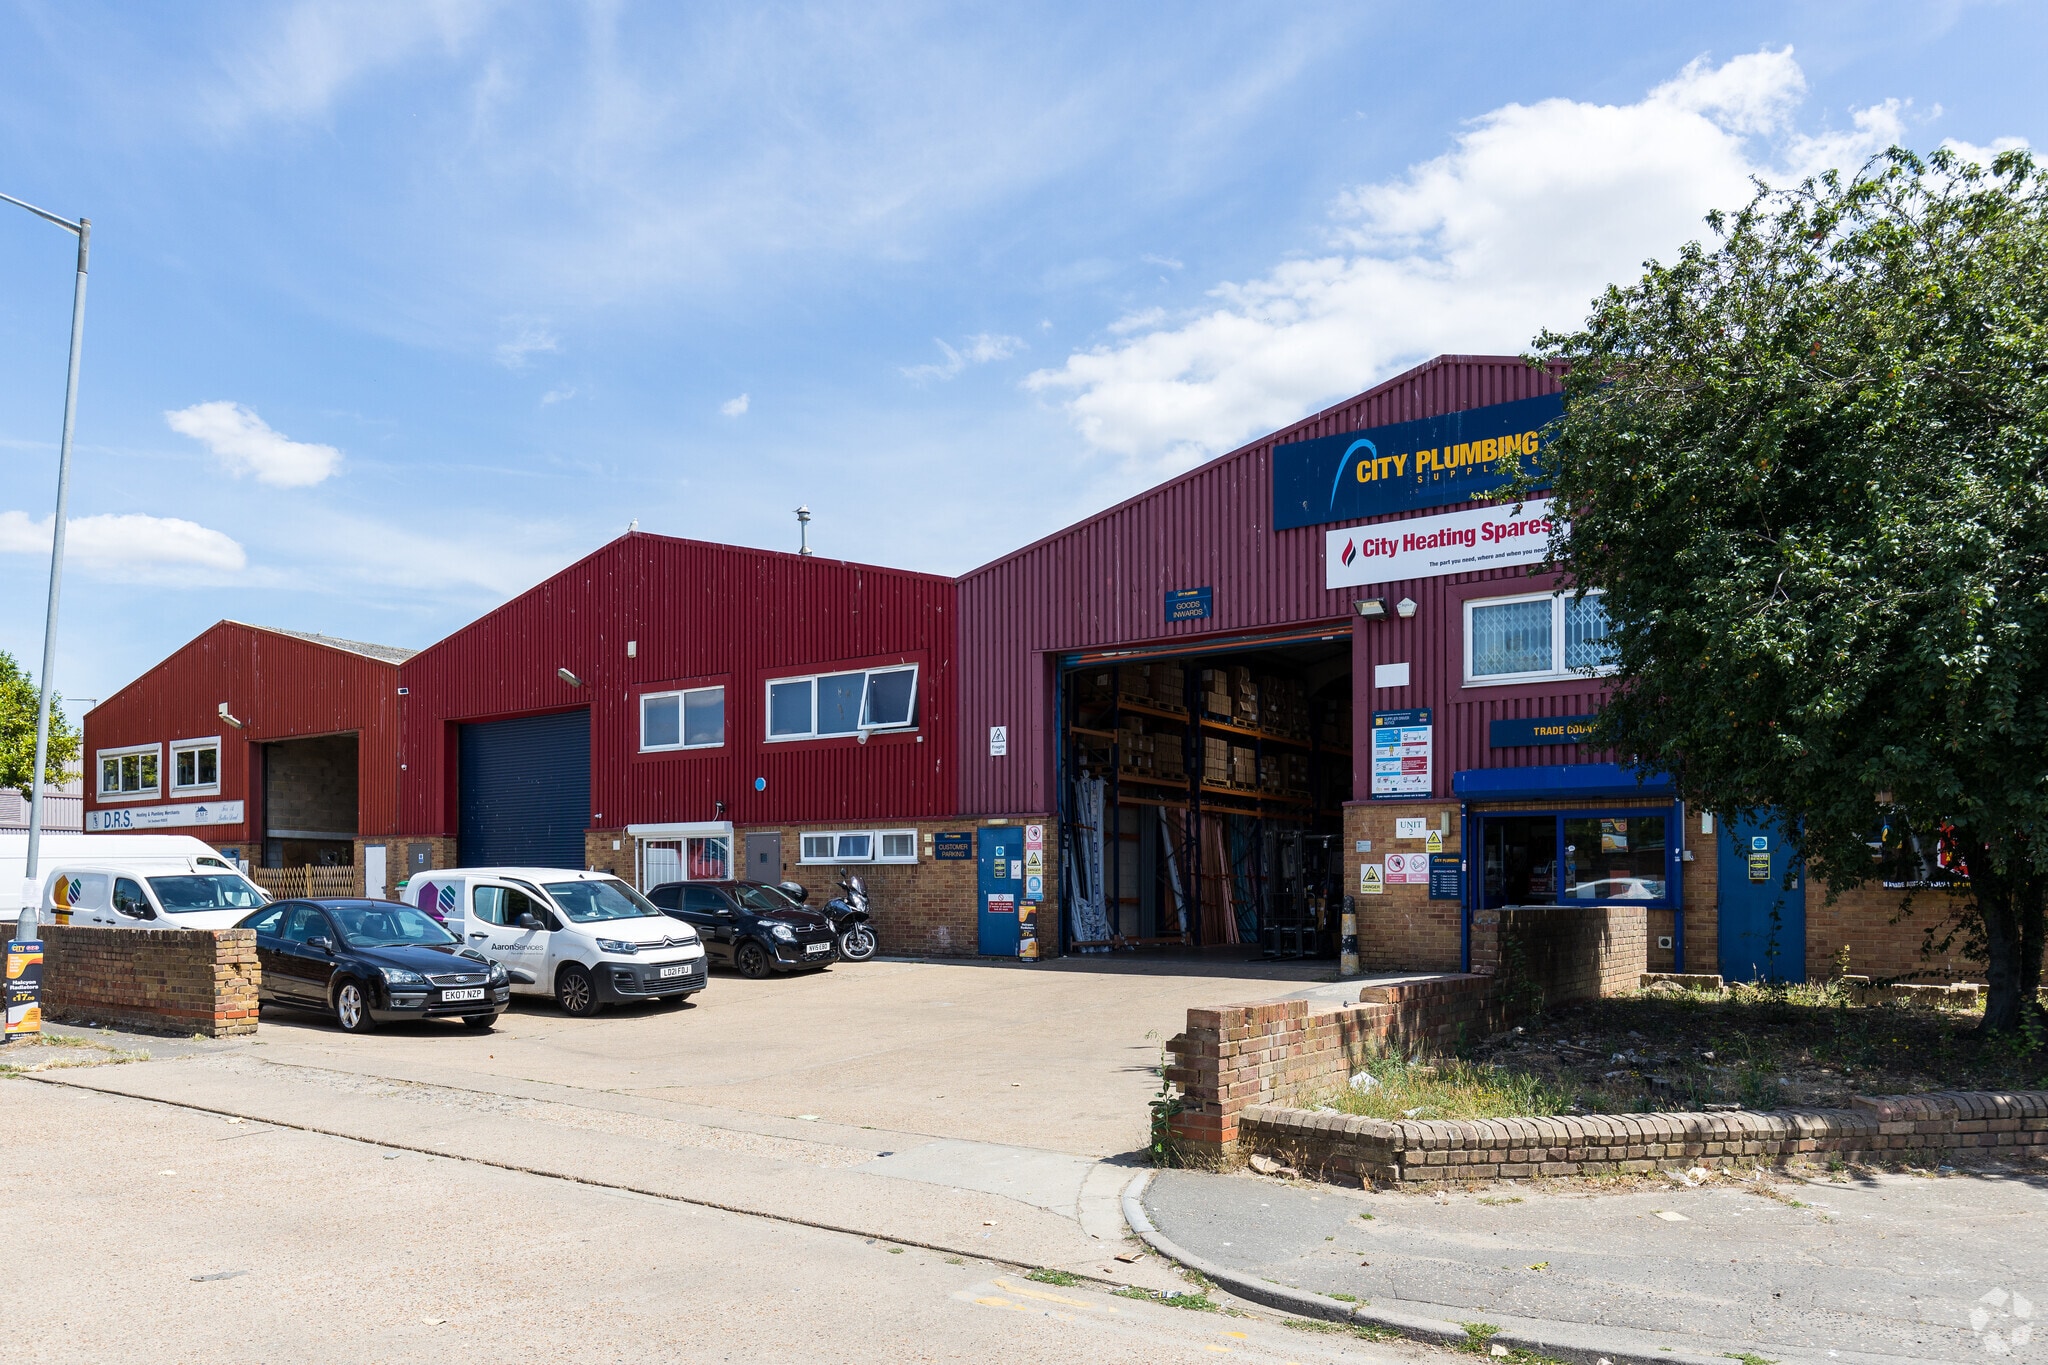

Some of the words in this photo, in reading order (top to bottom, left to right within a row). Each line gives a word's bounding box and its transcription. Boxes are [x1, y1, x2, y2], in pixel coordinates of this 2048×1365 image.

[1356, 453, 1408, 483] CITY
[1415, 430, 1539, 475] PLUMBING
[1417, 455, 1538, 484] SUPPLS
[1362, 538, 1399, 558] City
[1403, 527, 1476, 552] Heating
[1481, 518, 1552, 543] Spares
[1176, 600, 1201, 610] GOODS
[1173, 608, 1203, 619] INWARDS
[1533, 725, 1565, 736] TRADE
[1567, 724, 1594, 735] COUN
[104, 810, 133, 829] D.R.S.
[491, 943, 544, 951] AaronServices
[445, 990, 465, 1000] EK07
[467, 989, 482, 999] NZP
